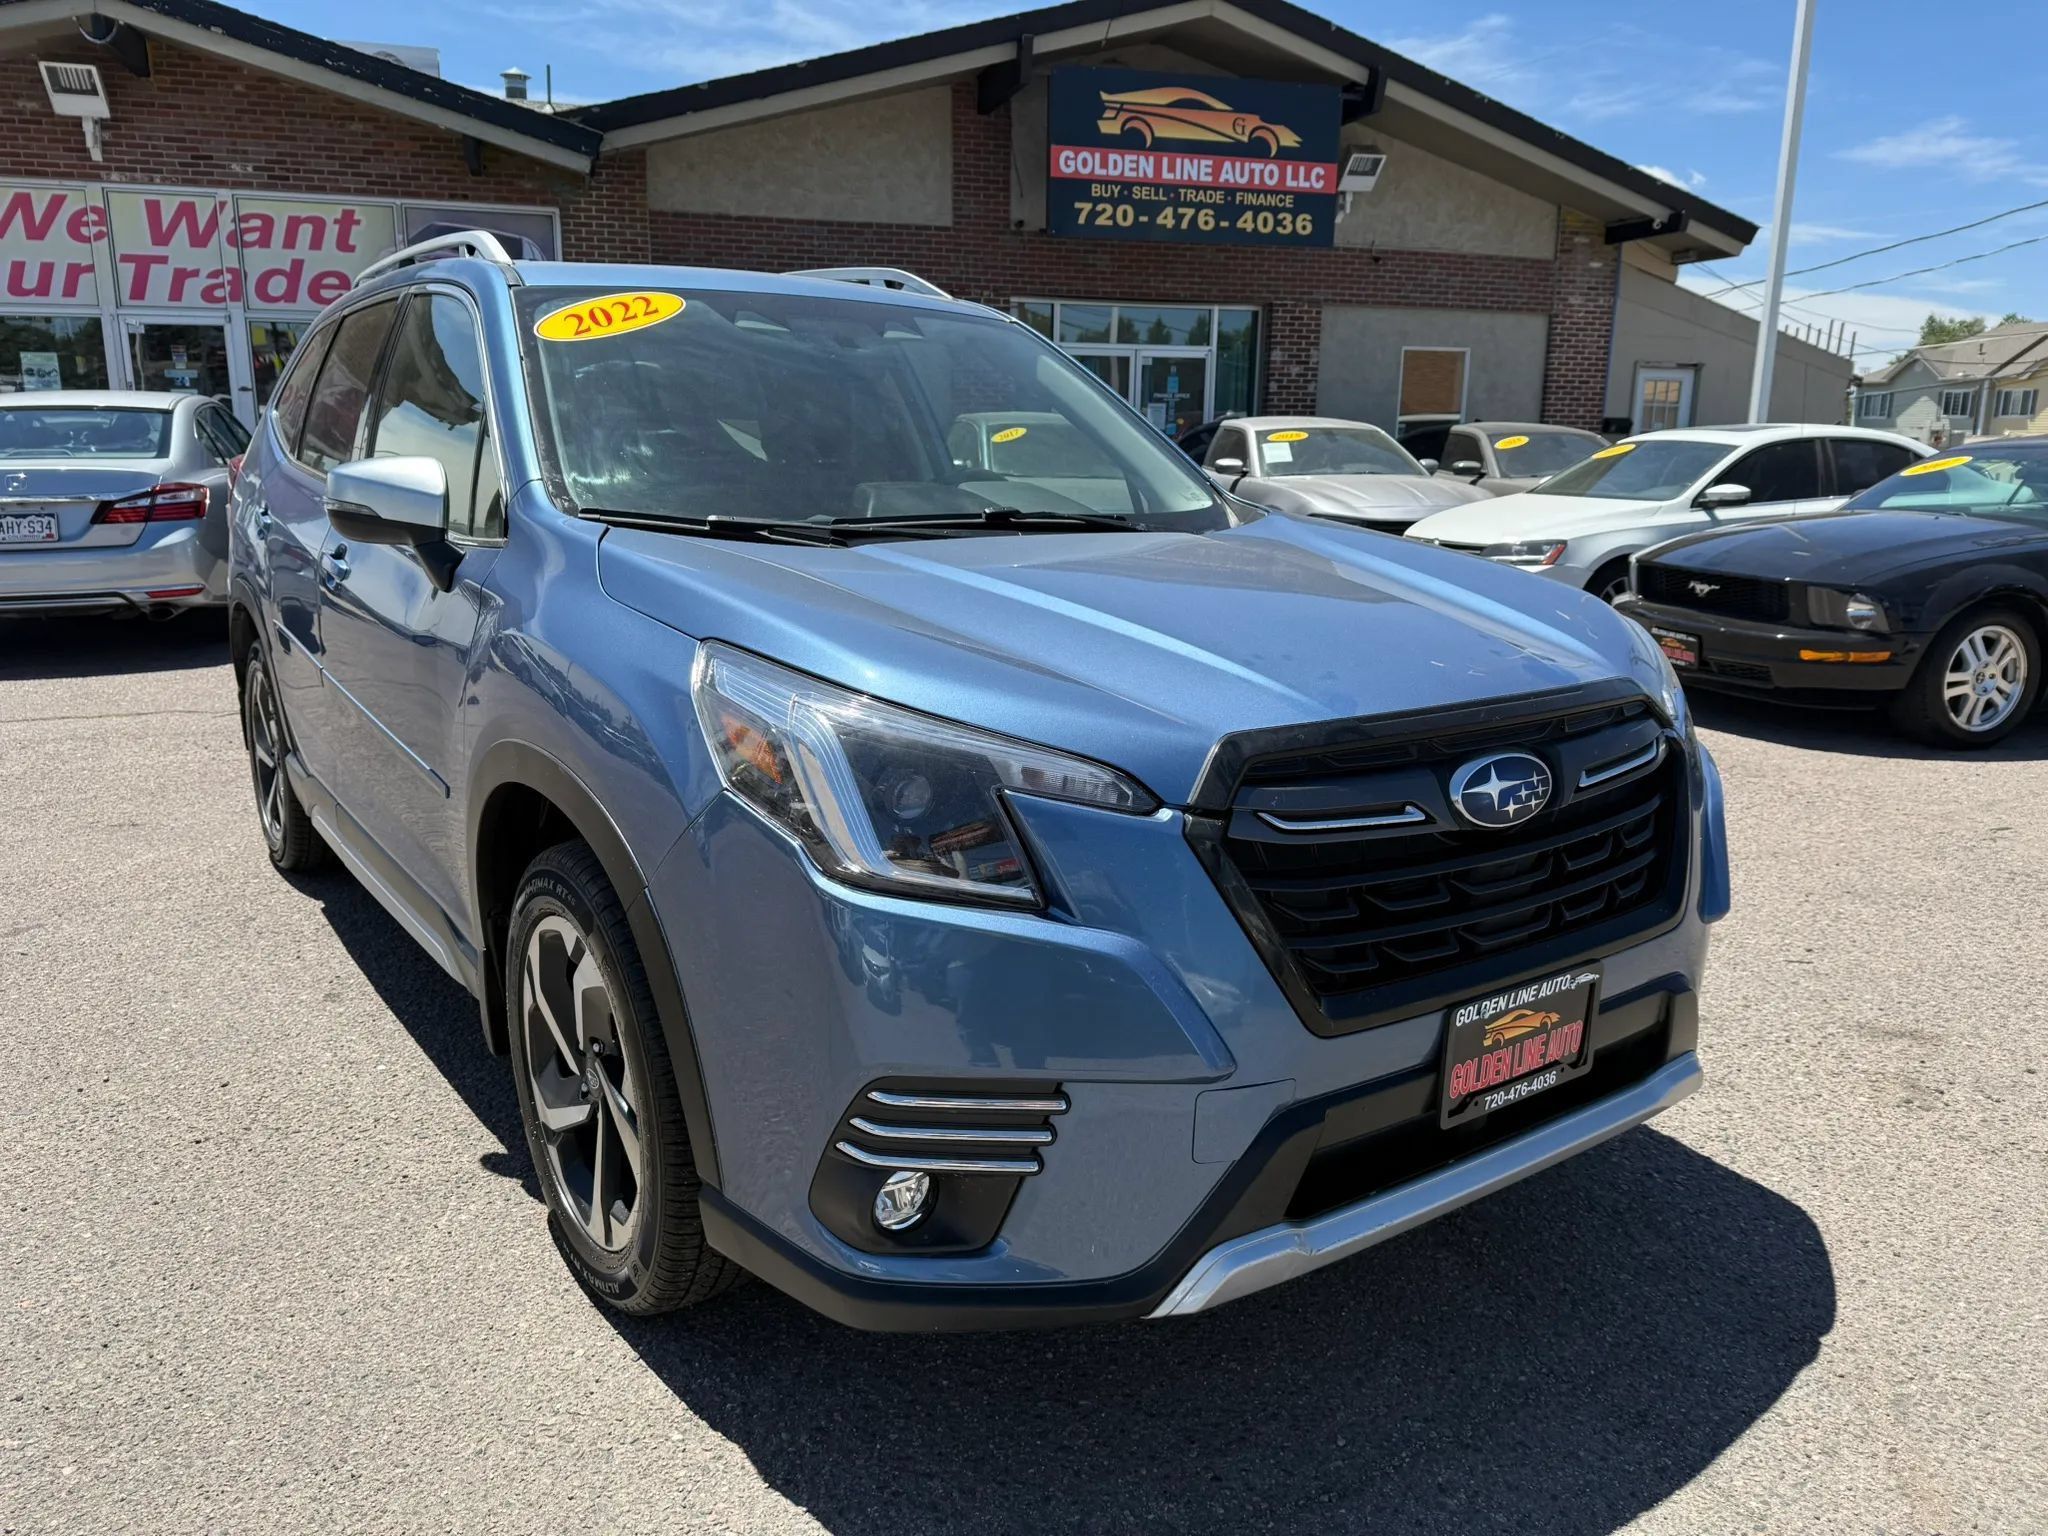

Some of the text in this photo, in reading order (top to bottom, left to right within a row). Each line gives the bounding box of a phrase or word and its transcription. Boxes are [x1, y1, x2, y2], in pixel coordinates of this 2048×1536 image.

[1059, 150, 1325, 189] GOLDEN LINE AUTO LLC
[1091, 184, 1294, 208] BUY SELL TRADE FINANCE
[0, 192, 361, 254] We Want
[119, 253, 351, 306] Trade
[564, 296, 659, 337] 2022
[1456, 974, 1571, 1027] GOLDEN LINE AUTO
[1450, 1020, 1584, 1099] GOLDEN LINE AUTO
[1484, 1071, 1557, 1111] 720-476-4036
